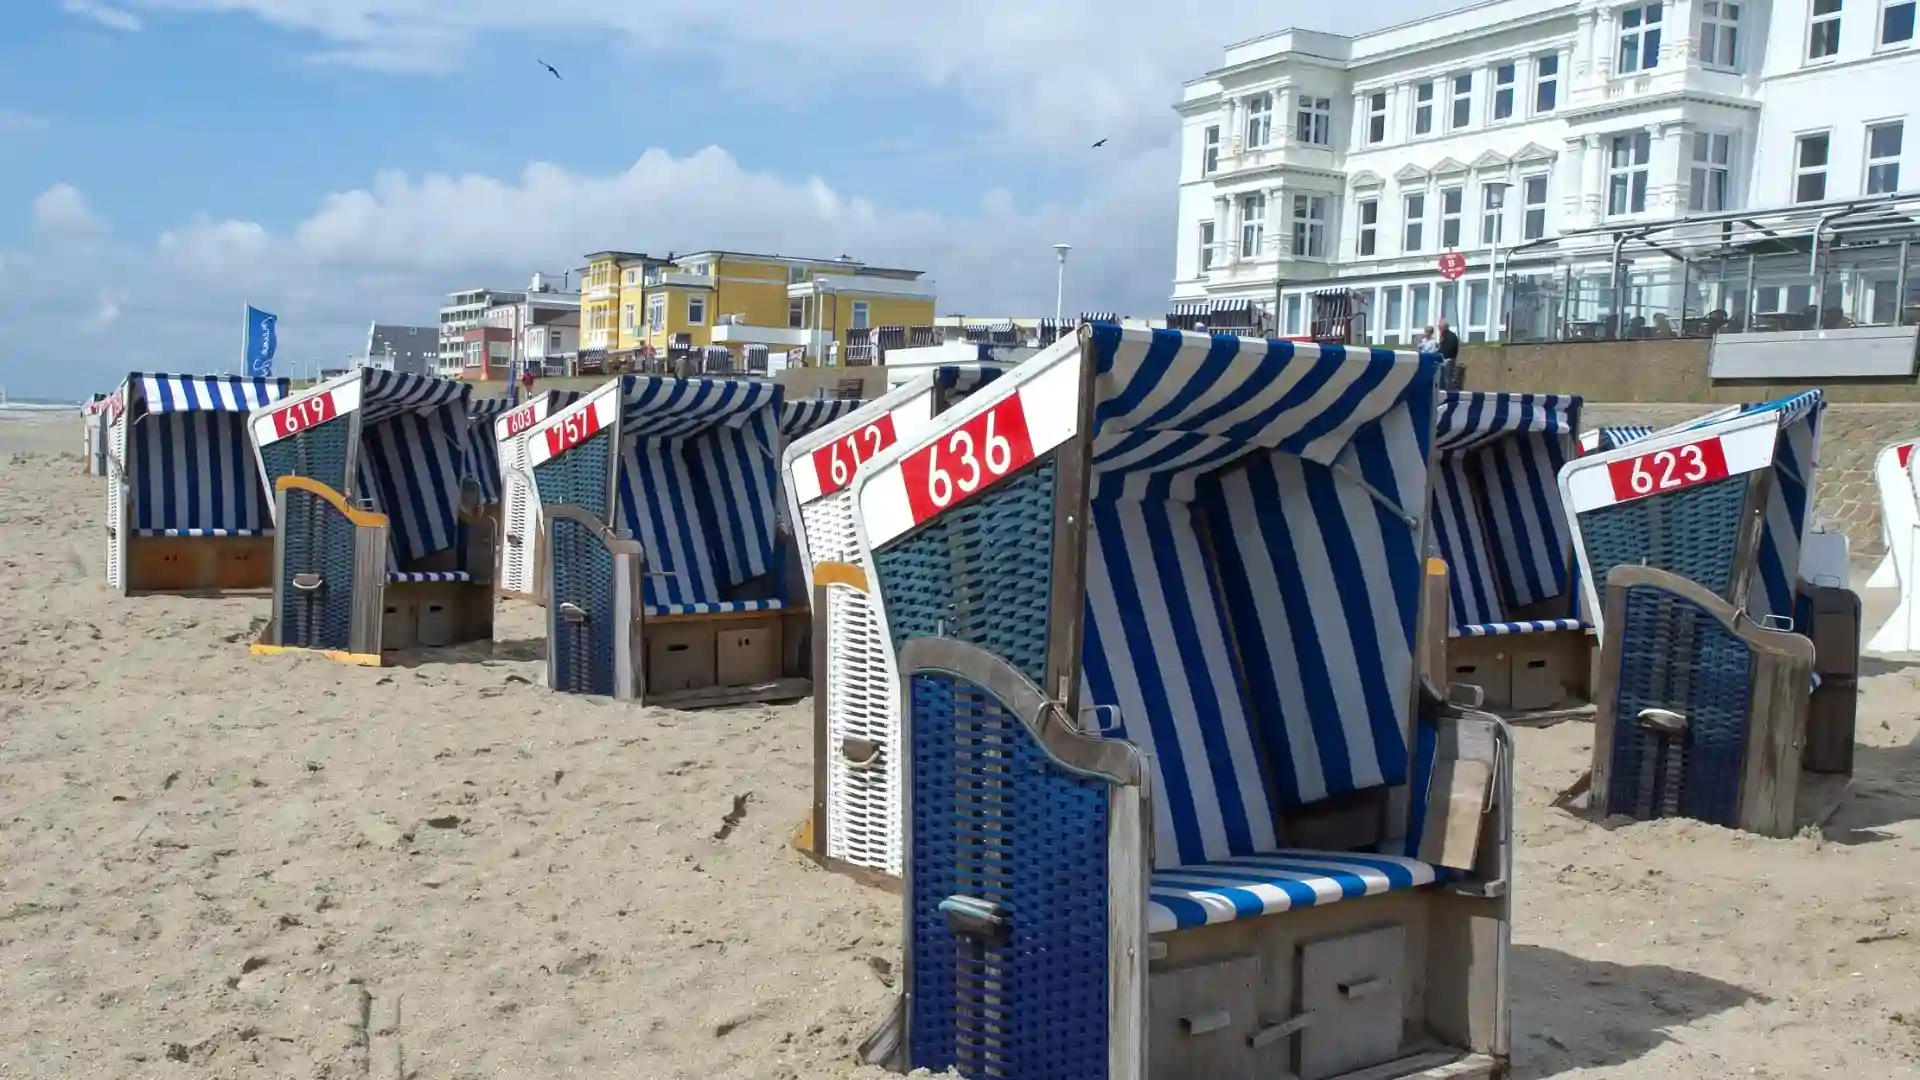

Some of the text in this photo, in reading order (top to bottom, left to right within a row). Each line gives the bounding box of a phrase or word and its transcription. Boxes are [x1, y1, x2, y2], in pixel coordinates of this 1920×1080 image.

[285, 397, 324, 432] 619
[511, 408, 532, 433] 603
[552, 408, 588, 450] 757
[830, 424, 882, 486] 612
[928, 409, 1012, 508] 636
[1630, 444, 1708, 494] 623
